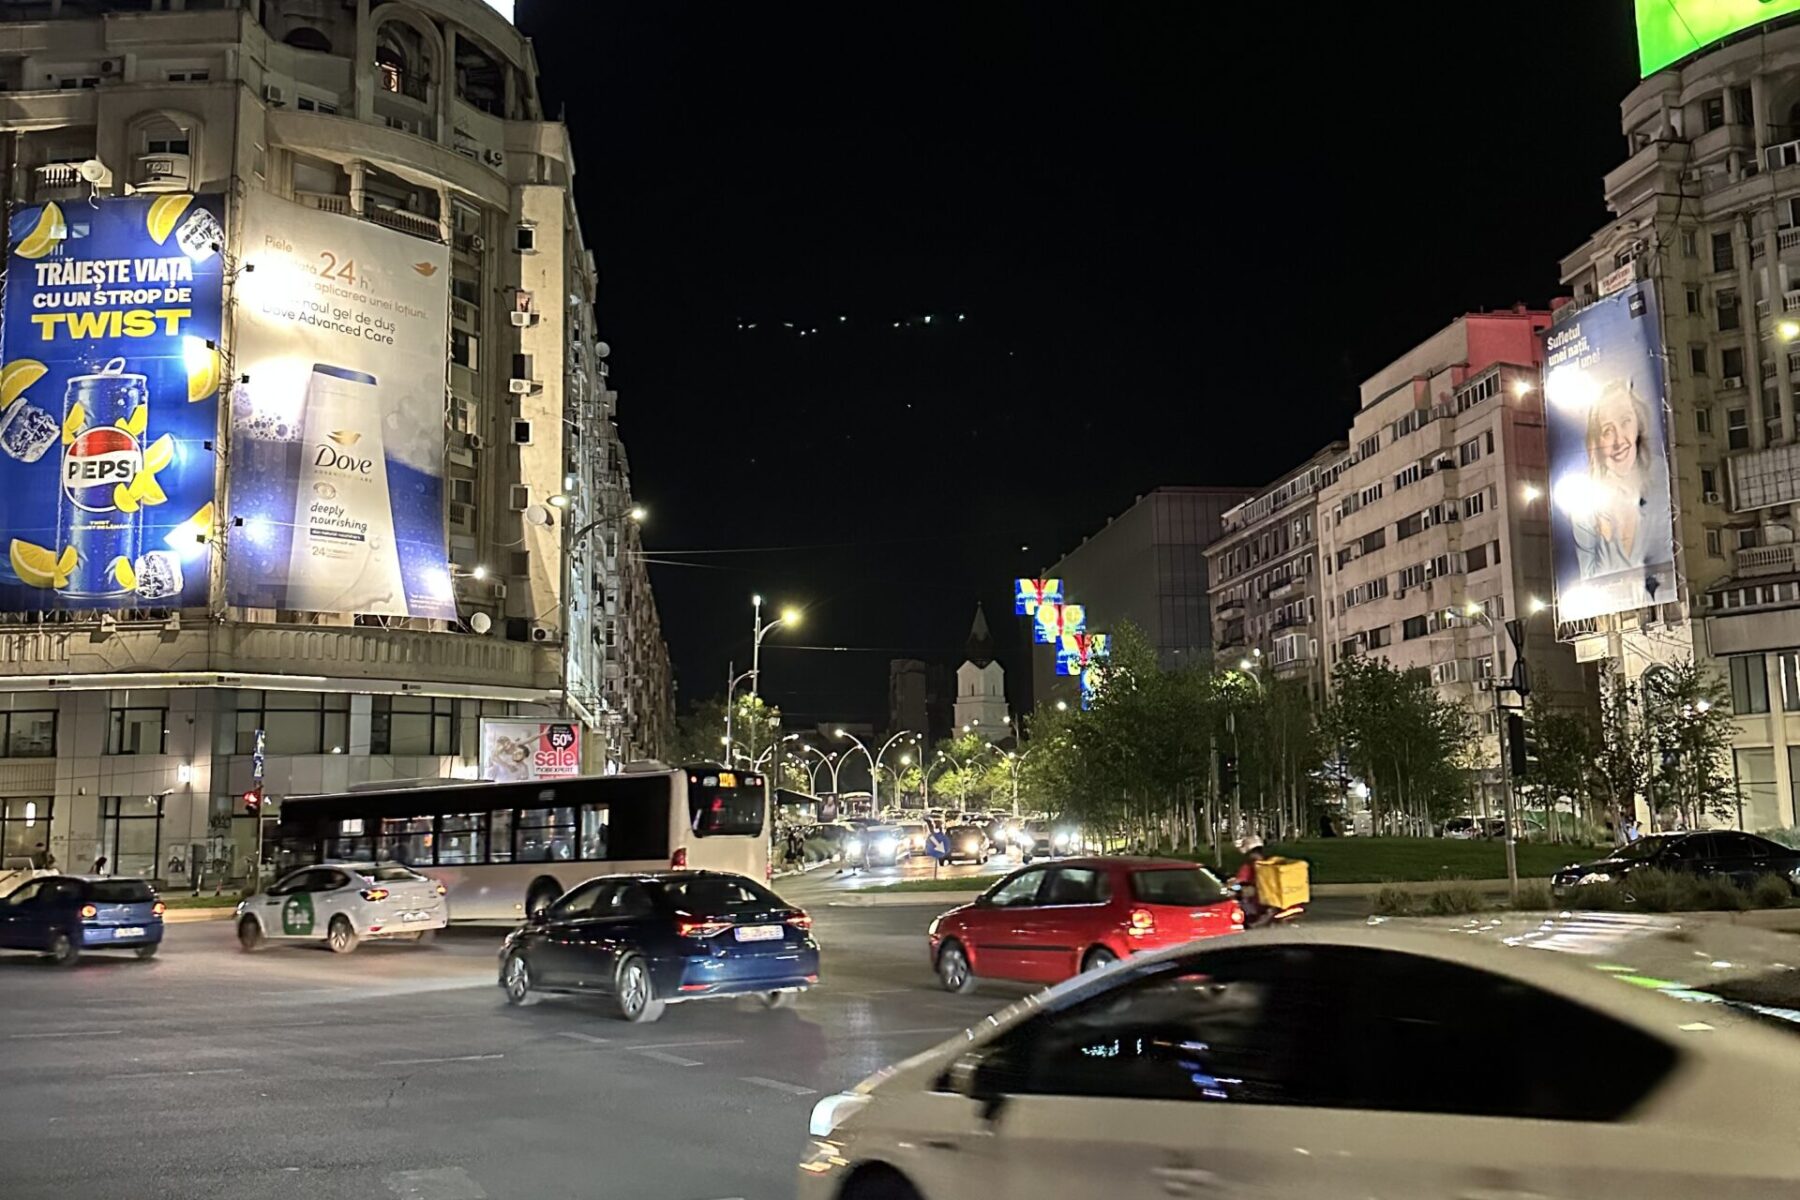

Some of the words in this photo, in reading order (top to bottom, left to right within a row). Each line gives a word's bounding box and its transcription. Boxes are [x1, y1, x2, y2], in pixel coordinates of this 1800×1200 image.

[35, 258, 131, 291] TRĂIEȘTE
[134, 257, 194, 288] VIAȚA
[320, 251, 357, 285] 24
[33, 293, 61, 308] CU
[63, 291, 91, 307] UN
[93, 289, 162, 306] STROP
[164, 288, 192, 303] DE
[369, 297, 393, 311] unei
[31, 309, 192, 341] TWIST
[298, 311, 361, 337] Advanced
[364, 328, 394, 345] Care
[333, 308, 352, 320] gel
[355, 312, 372, 326] de
[1547, 323, 1580, 350] Sufletul
[314, 444, 373, 475] Dove
[310, 502, 344, 517] deeply
[310, 515, 368, 533] nourishing
[534, 747, 575, 767] sale
